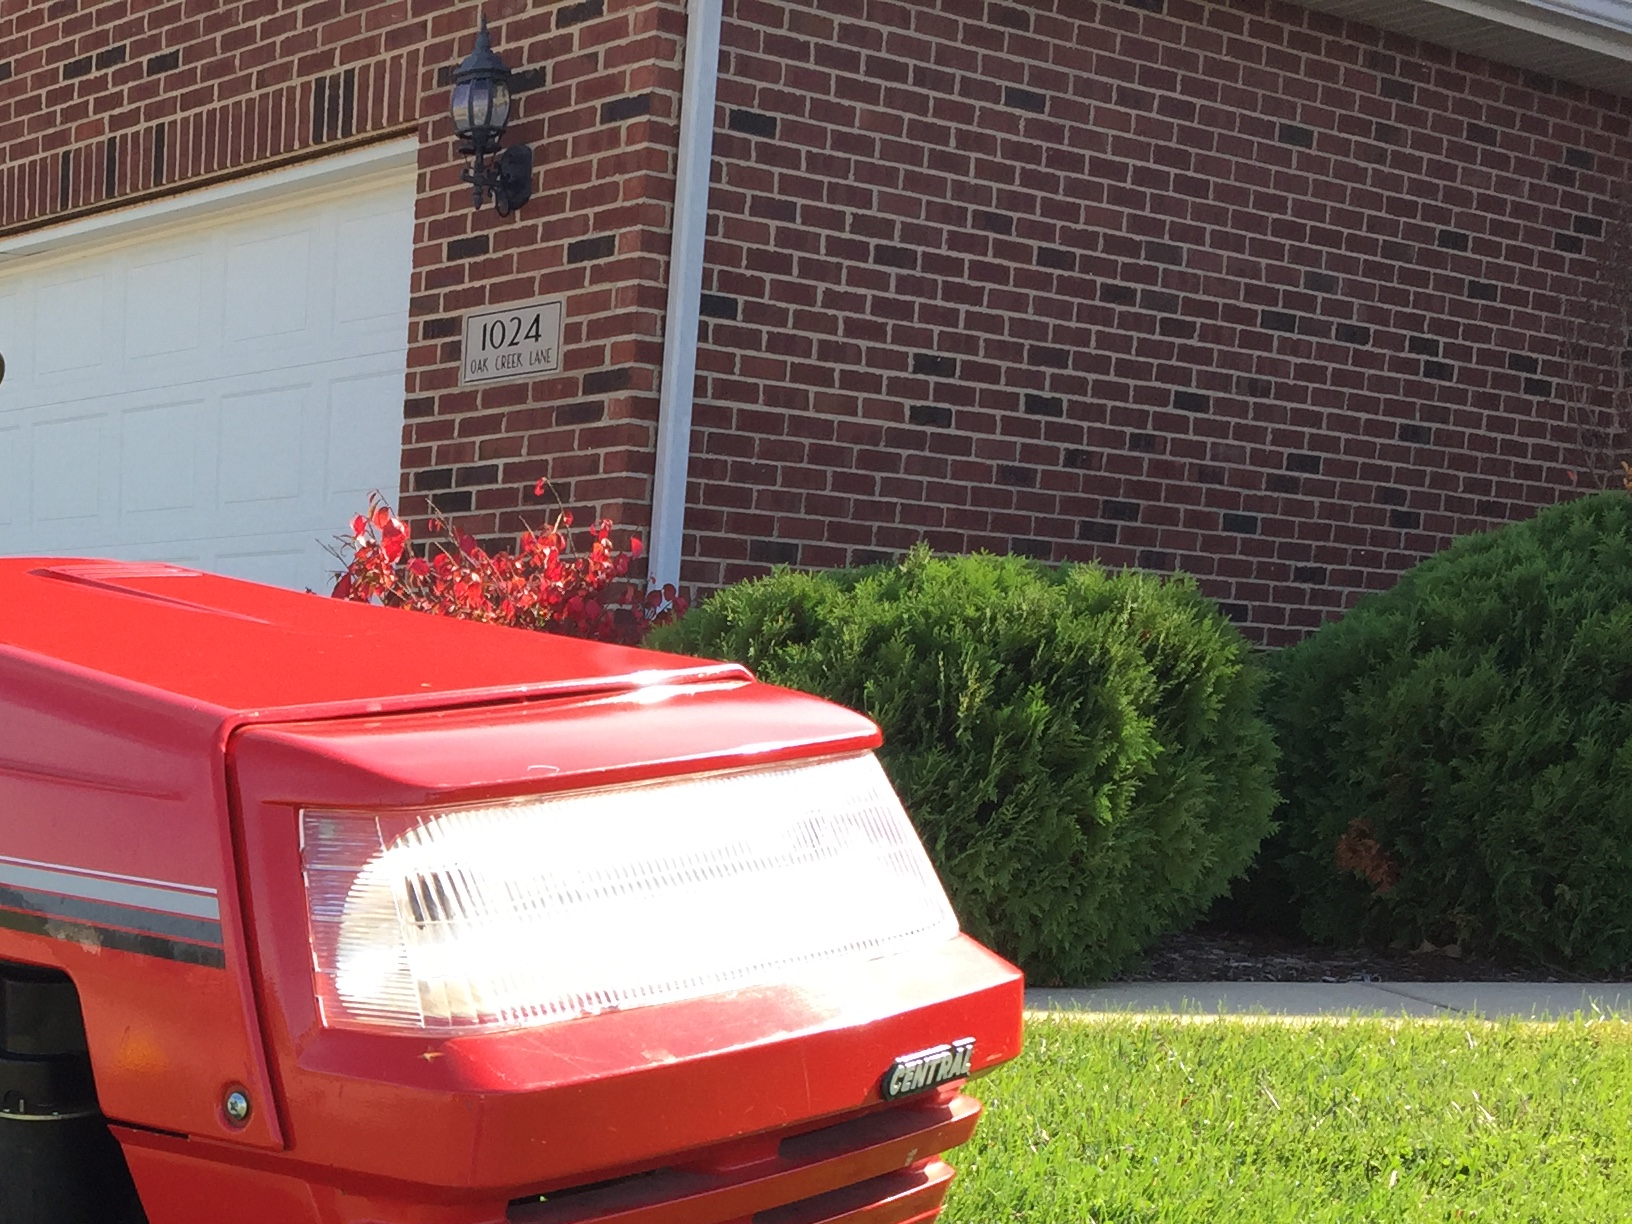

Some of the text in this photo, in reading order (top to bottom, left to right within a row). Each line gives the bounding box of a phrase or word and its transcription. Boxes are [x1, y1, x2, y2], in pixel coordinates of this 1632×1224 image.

[482, 313, 542, 351] 1024
[470, 348, 552, 374] OAK CREEK LANE
[889, 1044, 974, 1096] CENTRAL
